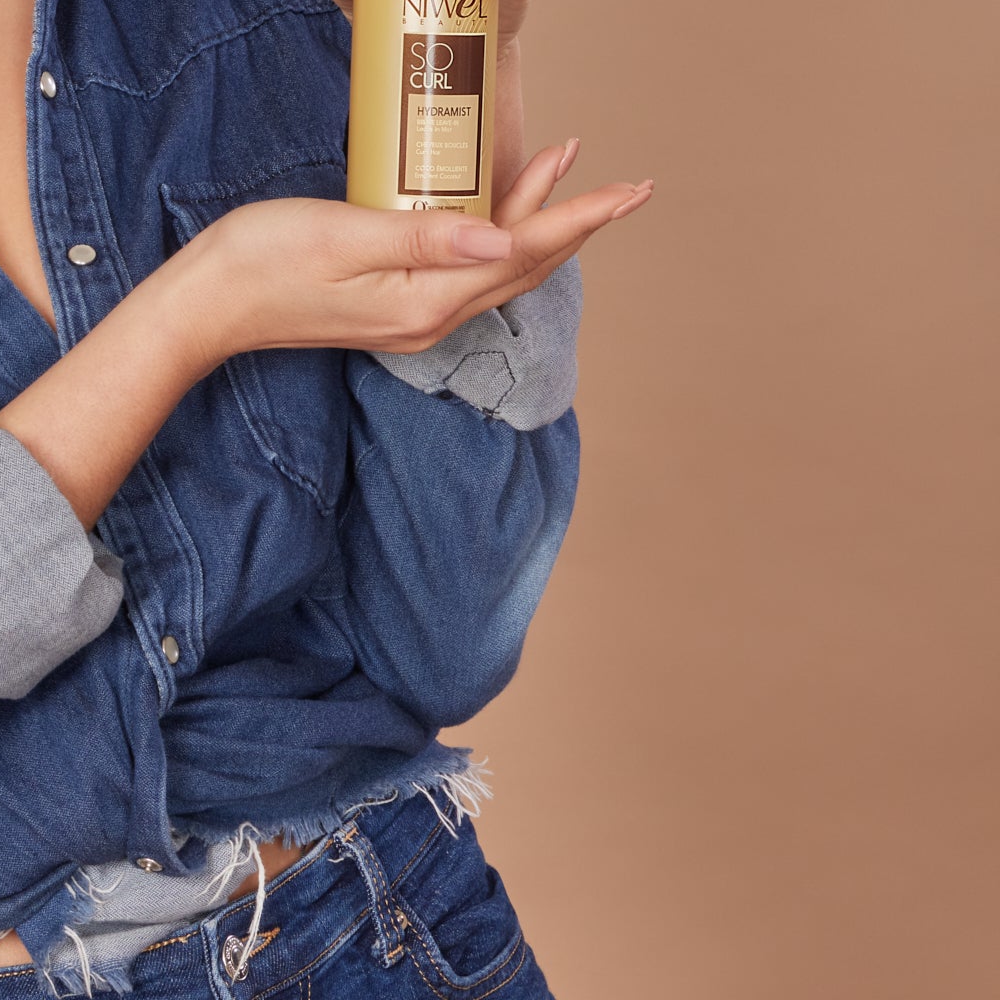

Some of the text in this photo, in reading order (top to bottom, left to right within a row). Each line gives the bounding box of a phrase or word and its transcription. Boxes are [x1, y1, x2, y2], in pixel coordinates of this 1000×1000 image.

[410, 42, 454, 71] SO
[409, 72, 453, 89] CURL
[417, 106, 472, 117] HYDRAMIST
